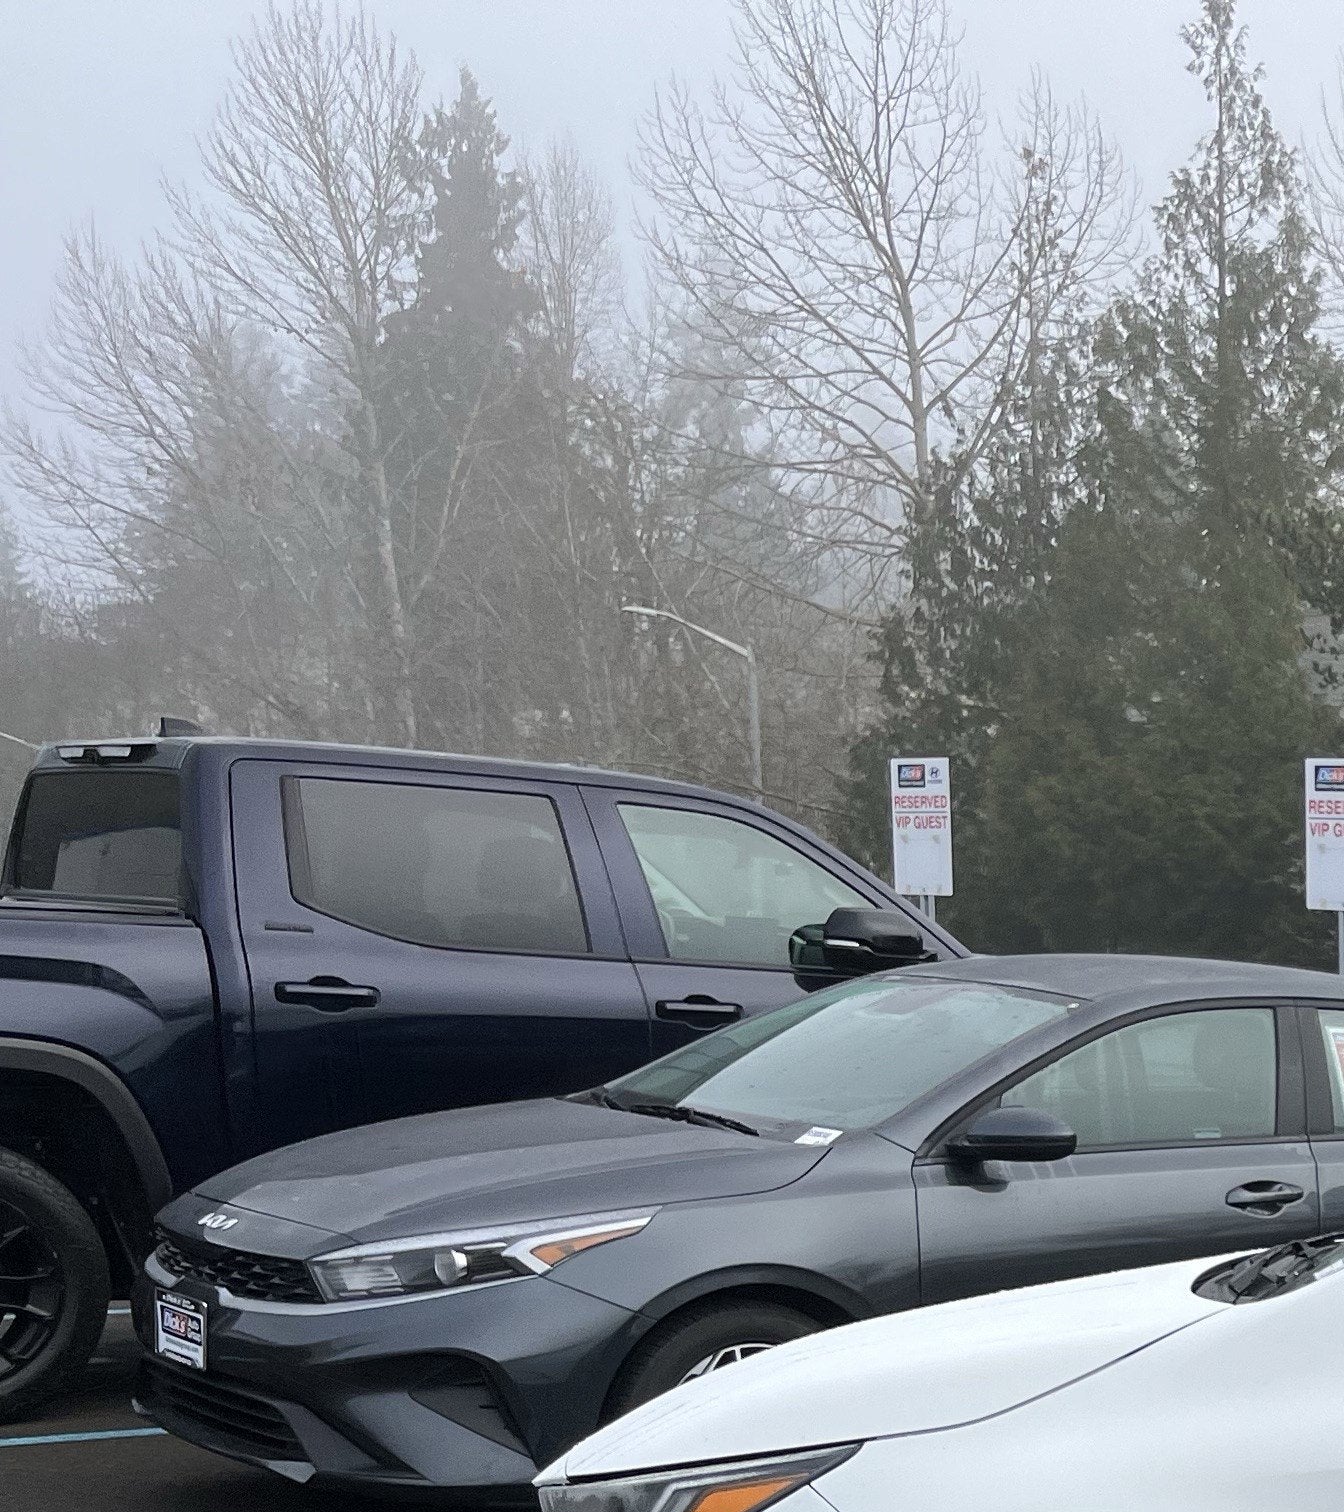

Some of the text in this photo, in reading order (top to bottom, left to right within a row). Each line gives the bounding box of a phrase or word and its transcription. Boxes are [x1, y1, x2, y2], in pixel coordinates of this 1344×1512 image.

[895, 795, 947, 808] RESERVED
[895, 816, 947, 829] VIP GUEST
[1310, 823, 1329, 836] VIP
